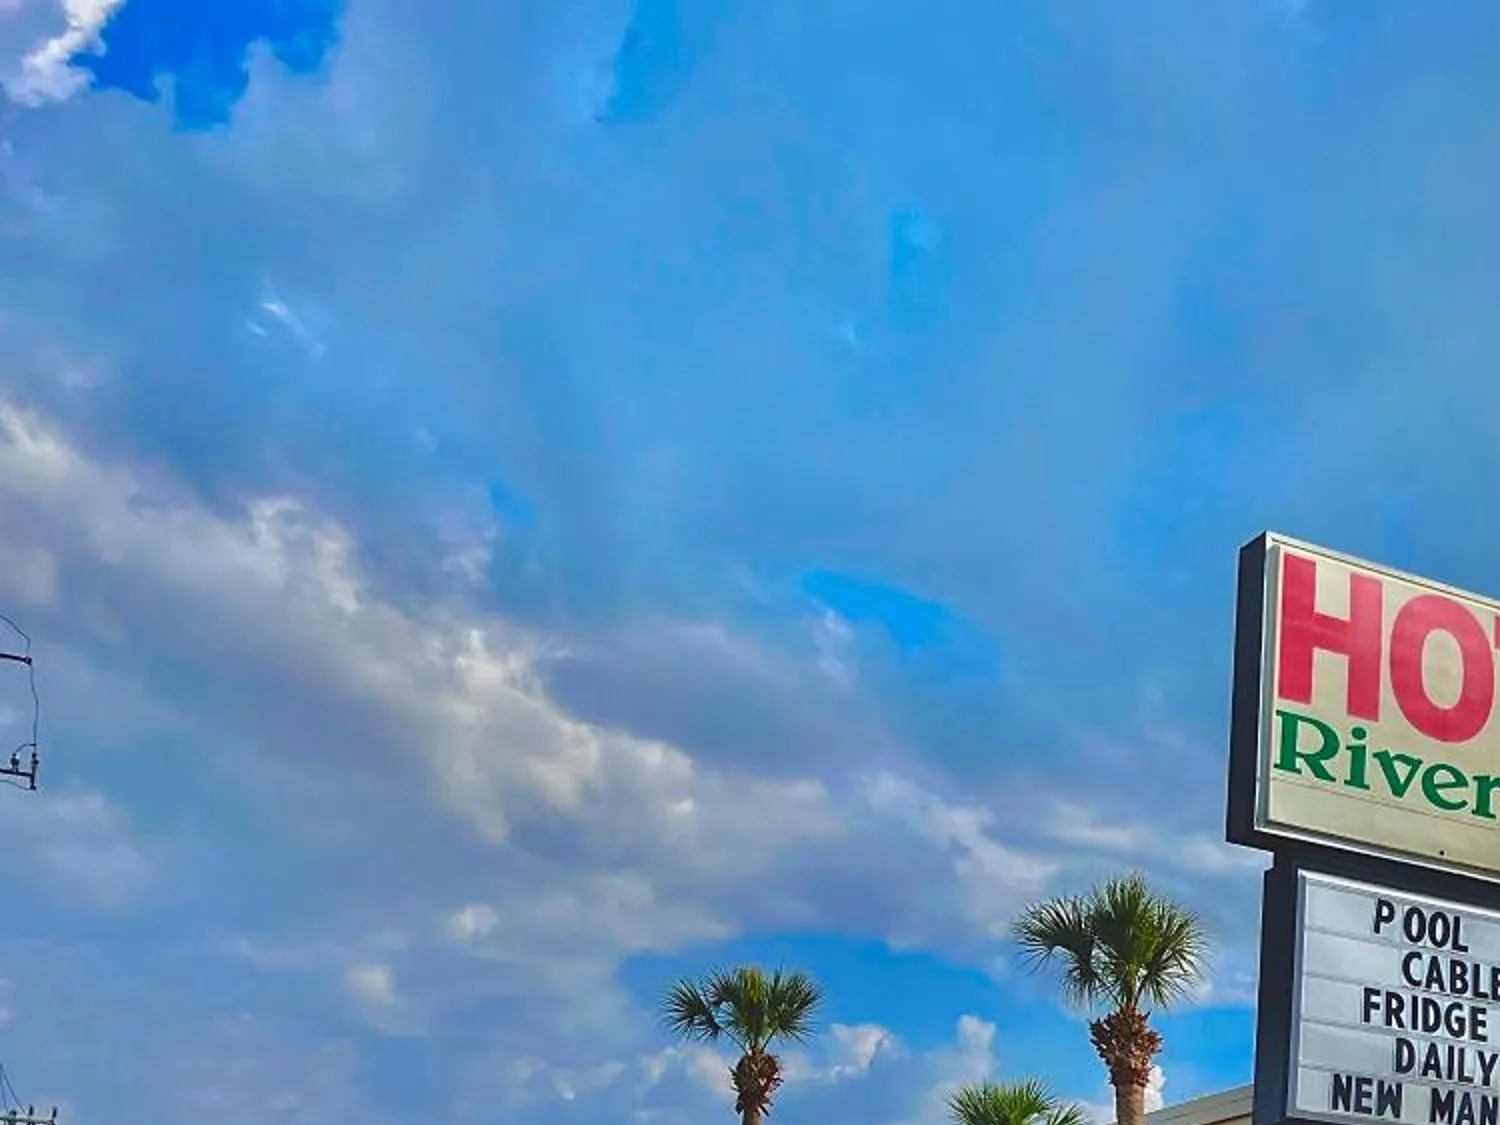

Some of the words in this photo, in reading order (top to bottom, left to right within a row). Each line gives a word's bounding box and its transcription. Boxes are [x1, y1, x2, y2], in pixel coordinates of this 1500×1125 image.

[1373, 898, 1469, 953] POOL
[1363, 987, 1488, 1042] FRIDGE
[1395, 1038, 1499, 1087] DAILY
[1332, 1073, 1401, 1118] NEW
